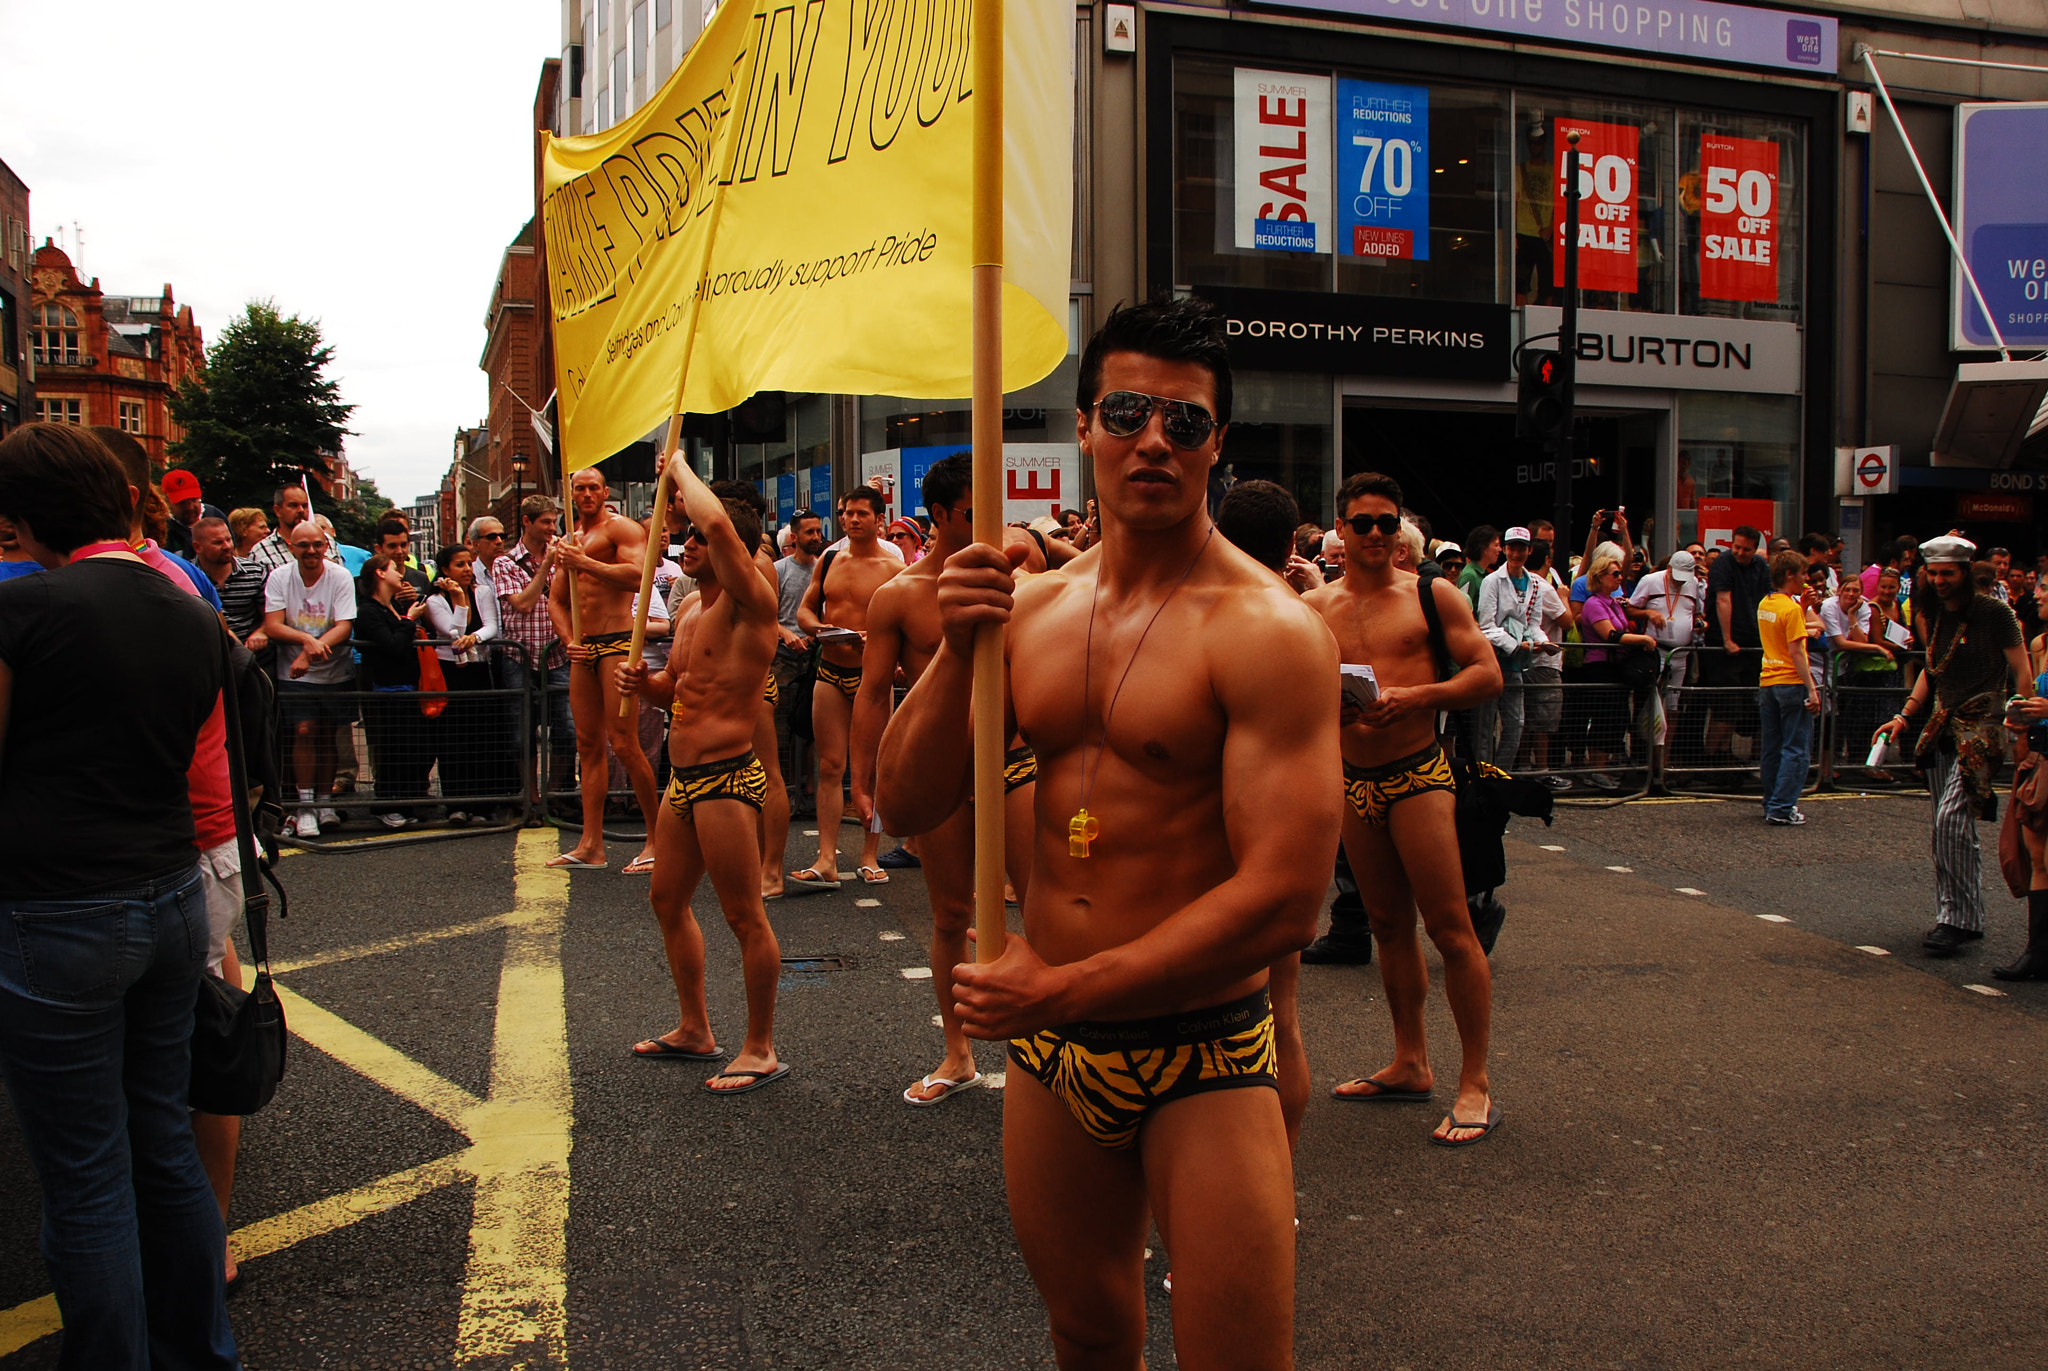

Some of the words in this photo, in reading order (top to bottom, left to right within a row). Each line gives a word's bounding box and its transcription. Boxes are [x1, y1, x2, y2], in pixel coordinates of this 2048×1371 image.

[1565, 0, 1732, 47] SHOPPING
[1802, 43, 1819, 53] one
[828, 0, 973, 164] YOU
[1257, 82, 1307, 97] SUMMER
[1353, 95, 1412, 112] FURTHER
[1353, 108, 1412, 124] REDUCTIONS
[1706, 142, 1735, 151] BURTON
[1258, 95, 1308, 224] SALE
[1353, 195, 1403, 219] OFF
[1594, 203, 1631, 222] OFF
[1266, 223, 1304, 236] FURTHER
[1737, 216, 1771, 235] OFF
[1255, 234, 1314, 249] REDUCTIONS
[1358, 229, 1380, 242] NEW
[1381, 231, 1405, 245] LINES
[1363, 242, 1400, 256] ADDED
[1705, 234, 1771, 264] SALE
[710, 259, 792, 304] proudly
[789, 240, 877, 290] support
[872, 228, 937, 270] Pride
[2008, 259, 2048, 279] we
[2008, 313, 2048, 324] SHOPP
[1226, 319, 1363, 342] DOROTHY
[1373, 327, 1485, 349] PERKINS
[1577, 332, 1751, 370] BURTON
[1005, 457, 1061, 468] SUMMER
[1516, 457, 1601, 484] BURON
[1990, 473, 2033, 490] BOND
[1972, 503, 2016, 513] McDonald's
[1177, 1018, 1221, 1035] Calvin
[1222, 1008, 1250, 1026] Klein
[1079, 1026, 1117, 1041] Calvin
[1119, 1030, 1150, 1041] Klein
